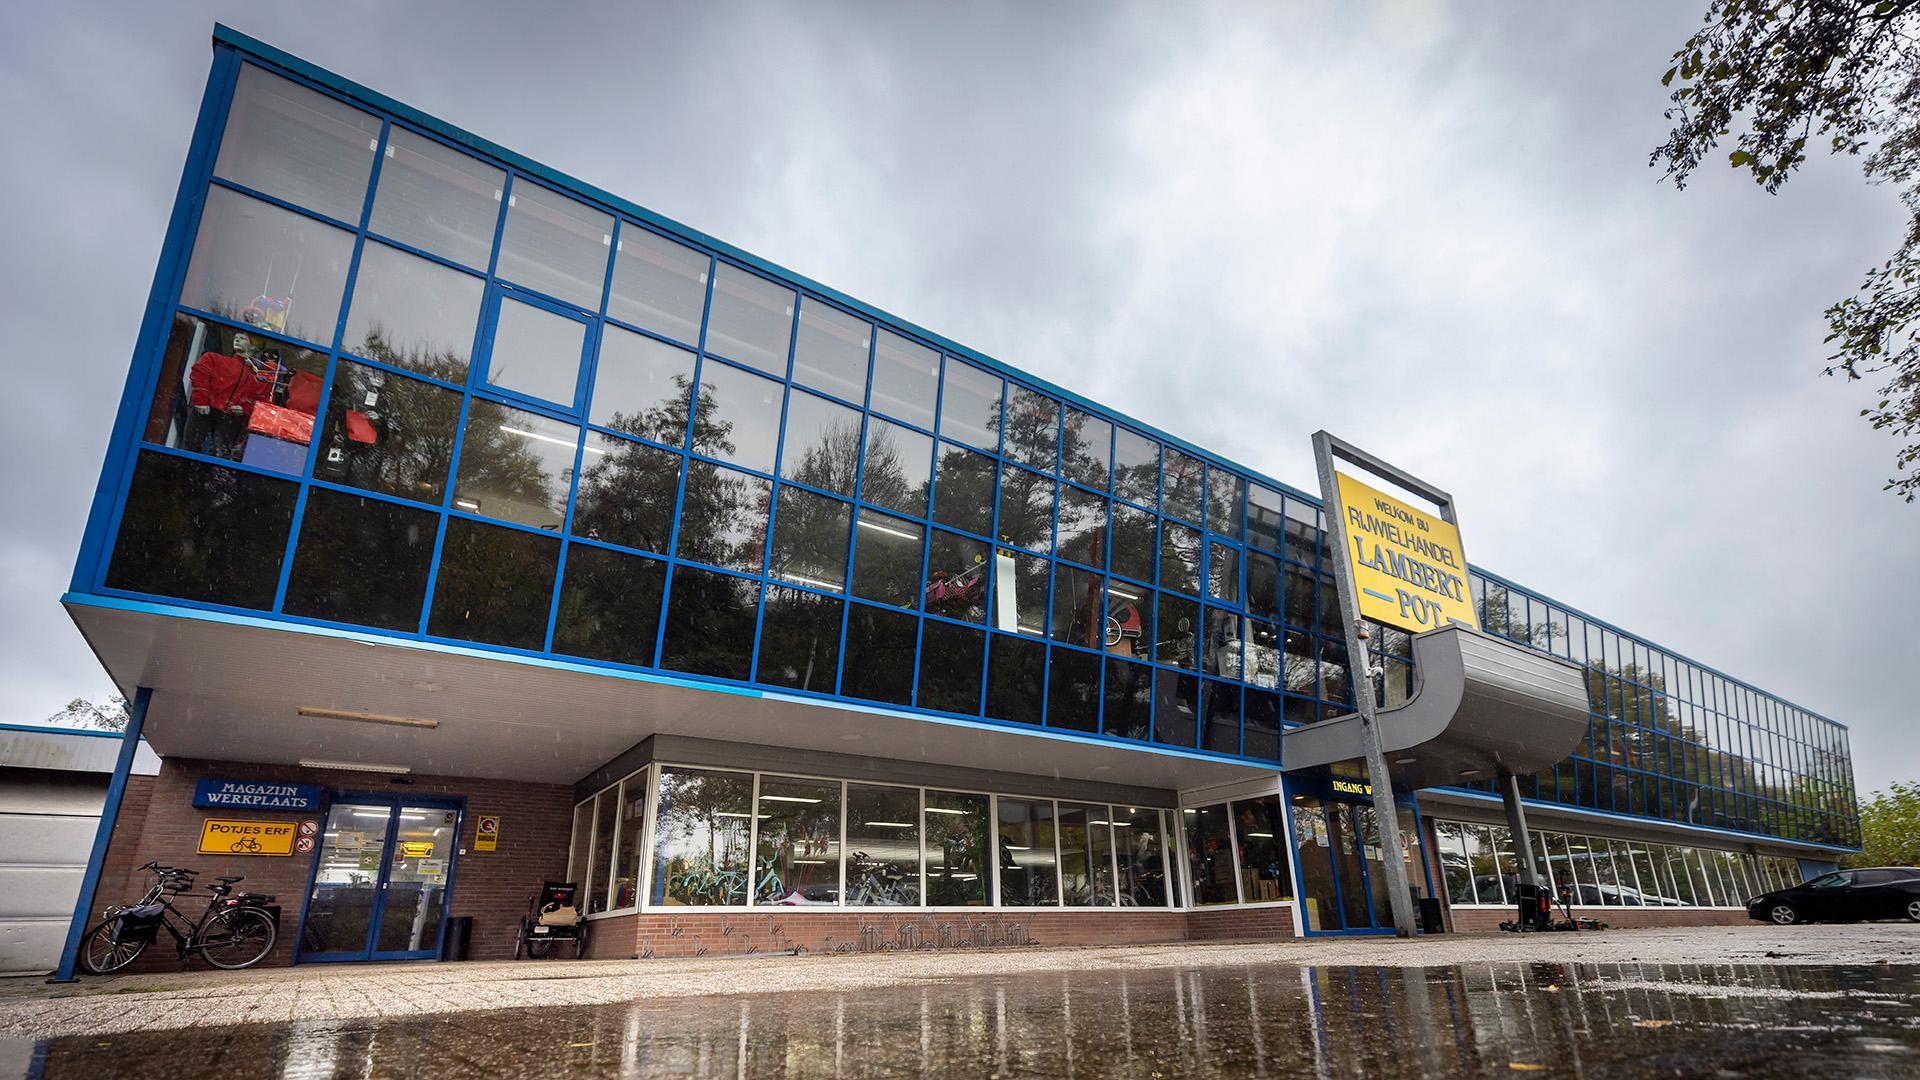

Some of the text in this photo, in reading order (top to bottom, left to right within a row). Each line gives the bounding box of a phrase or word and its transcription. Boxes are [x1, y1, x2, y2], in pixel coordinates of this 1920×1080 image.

[1374, 498, 1429, 532] WELKOM BIJ
[1348, 505, 1460, 570] RIJWIELHANDEL
[1353, 535, 1464, 603] LAMBERT
[1395, 588, 1442, 629] POT
[221, 783, 298, 797] MAGAZIJN
[1332, 780, 1363, 794] INGANG
[207, 792, 308, 808] WERKPLAATS
[210, 823, 291, 835] POTJES ERF
